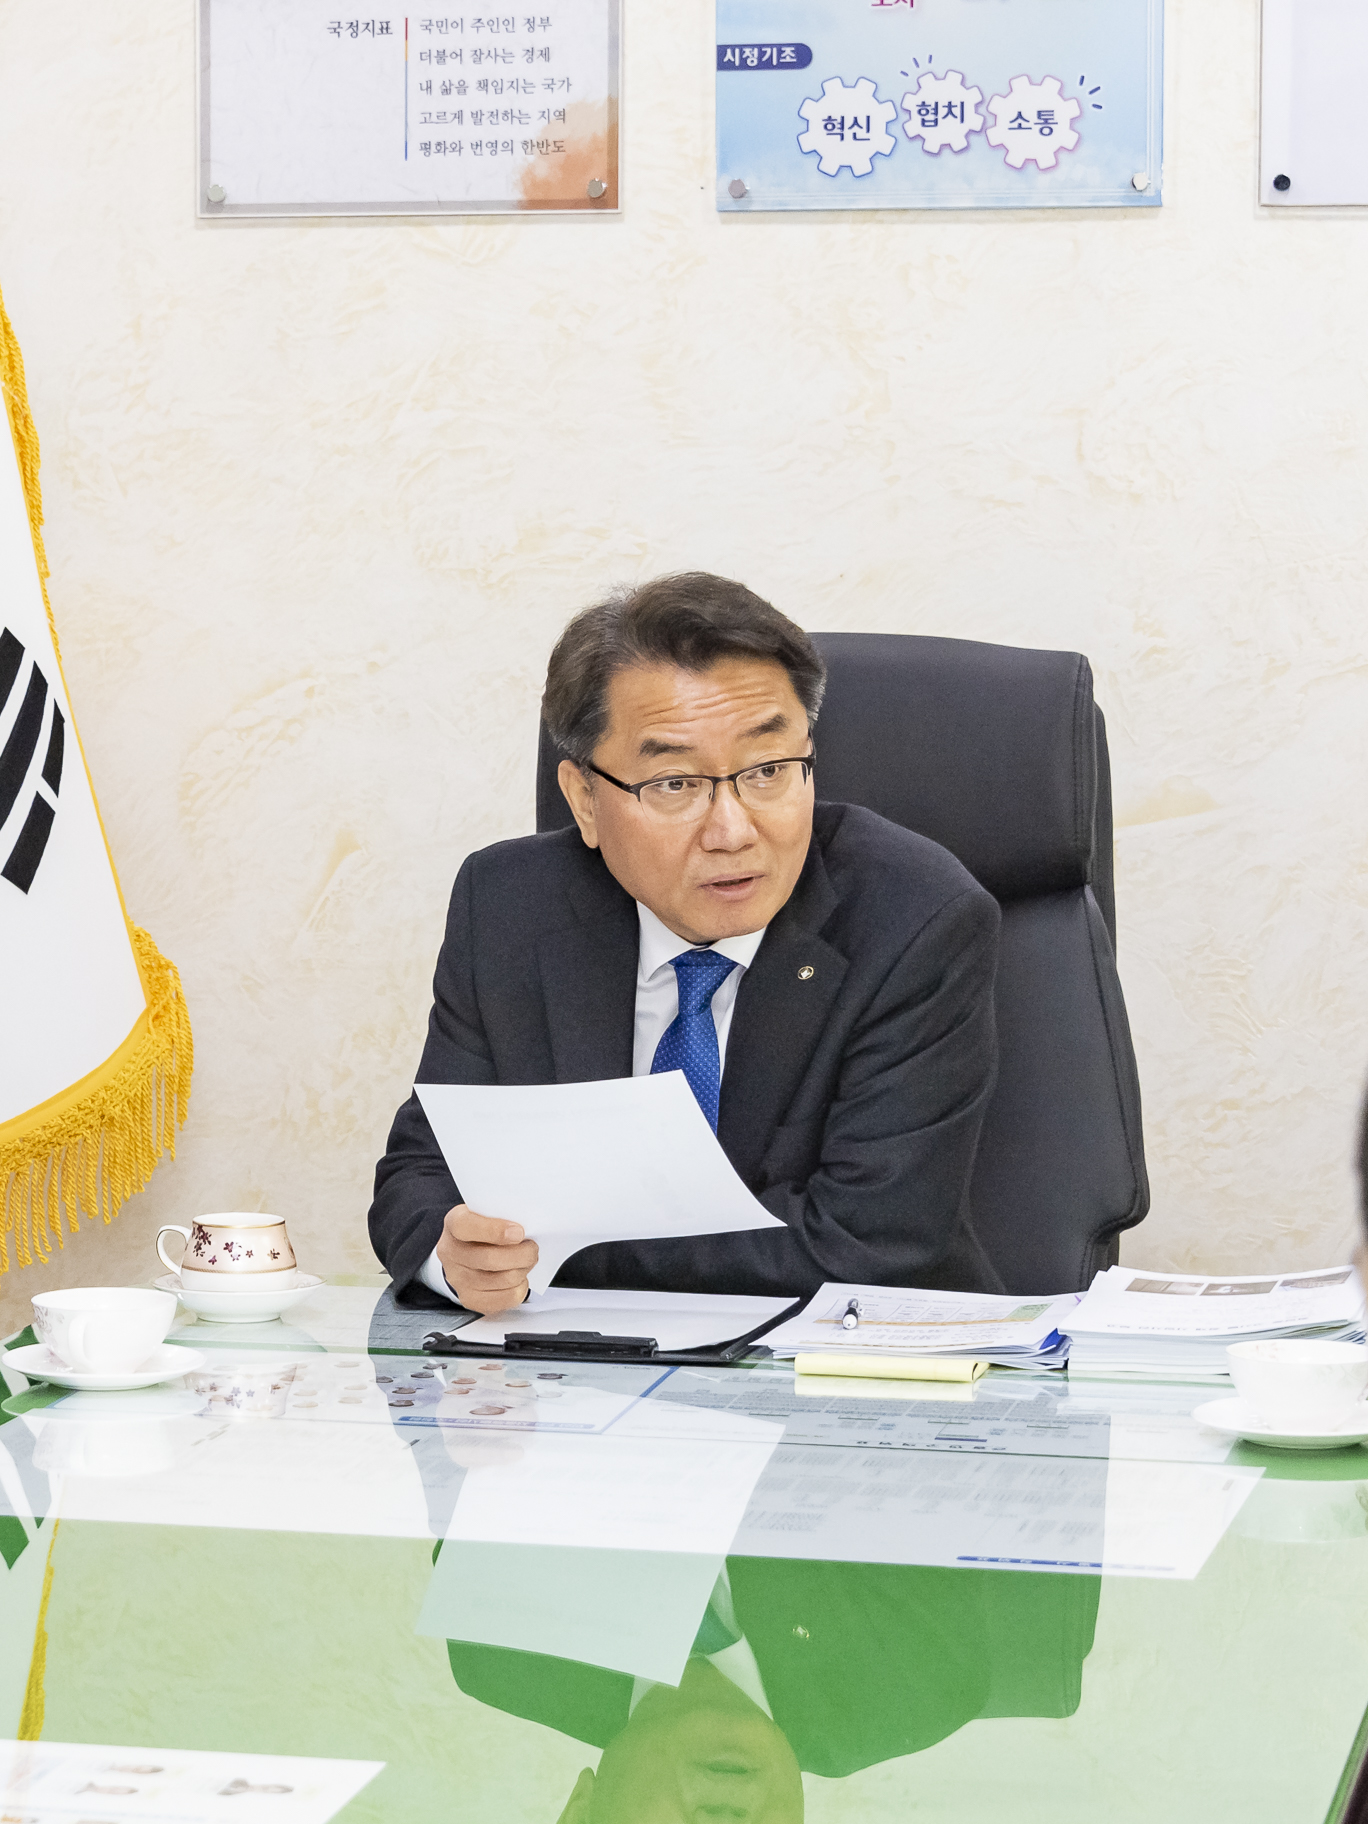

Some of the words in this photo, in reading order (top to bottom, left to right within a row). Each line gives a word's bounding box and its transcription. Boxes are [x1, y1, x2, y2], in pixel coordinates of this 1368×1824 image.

[327, 20, 393, 38] 국정지표
[420, 17, 464, 34] 국민이
[470, 16, 516, 33] 주인인
[523, 16, 552, 33] 정부
[419, 48, 464, 65] 더불어
[470, 48, 516, 64] 잘사는
[522, 47, 551, 63] 경제
[723, 46, 797, 66] 시정기조
[419, 79, 432, 96] 내
[439, 78, 469, 96] 삶을
[476, 78, 536, 95] 책임지는
[541, 77, 572, 94] 국가
[419, 109, 464, 125] 고르게
[470, 109, 531, 126] 발전하는
[537, 108, 566, 125] 지역
[916, 101, 965, 128] 협치
[1007, 109, 1058, 136] 소통
[822, 115, 871, 142] 혁신
[419, 140, 464, 158] 평화와
[470, 139, 514, 156] 번영의
[521, 139, 566, 156] 한반도
